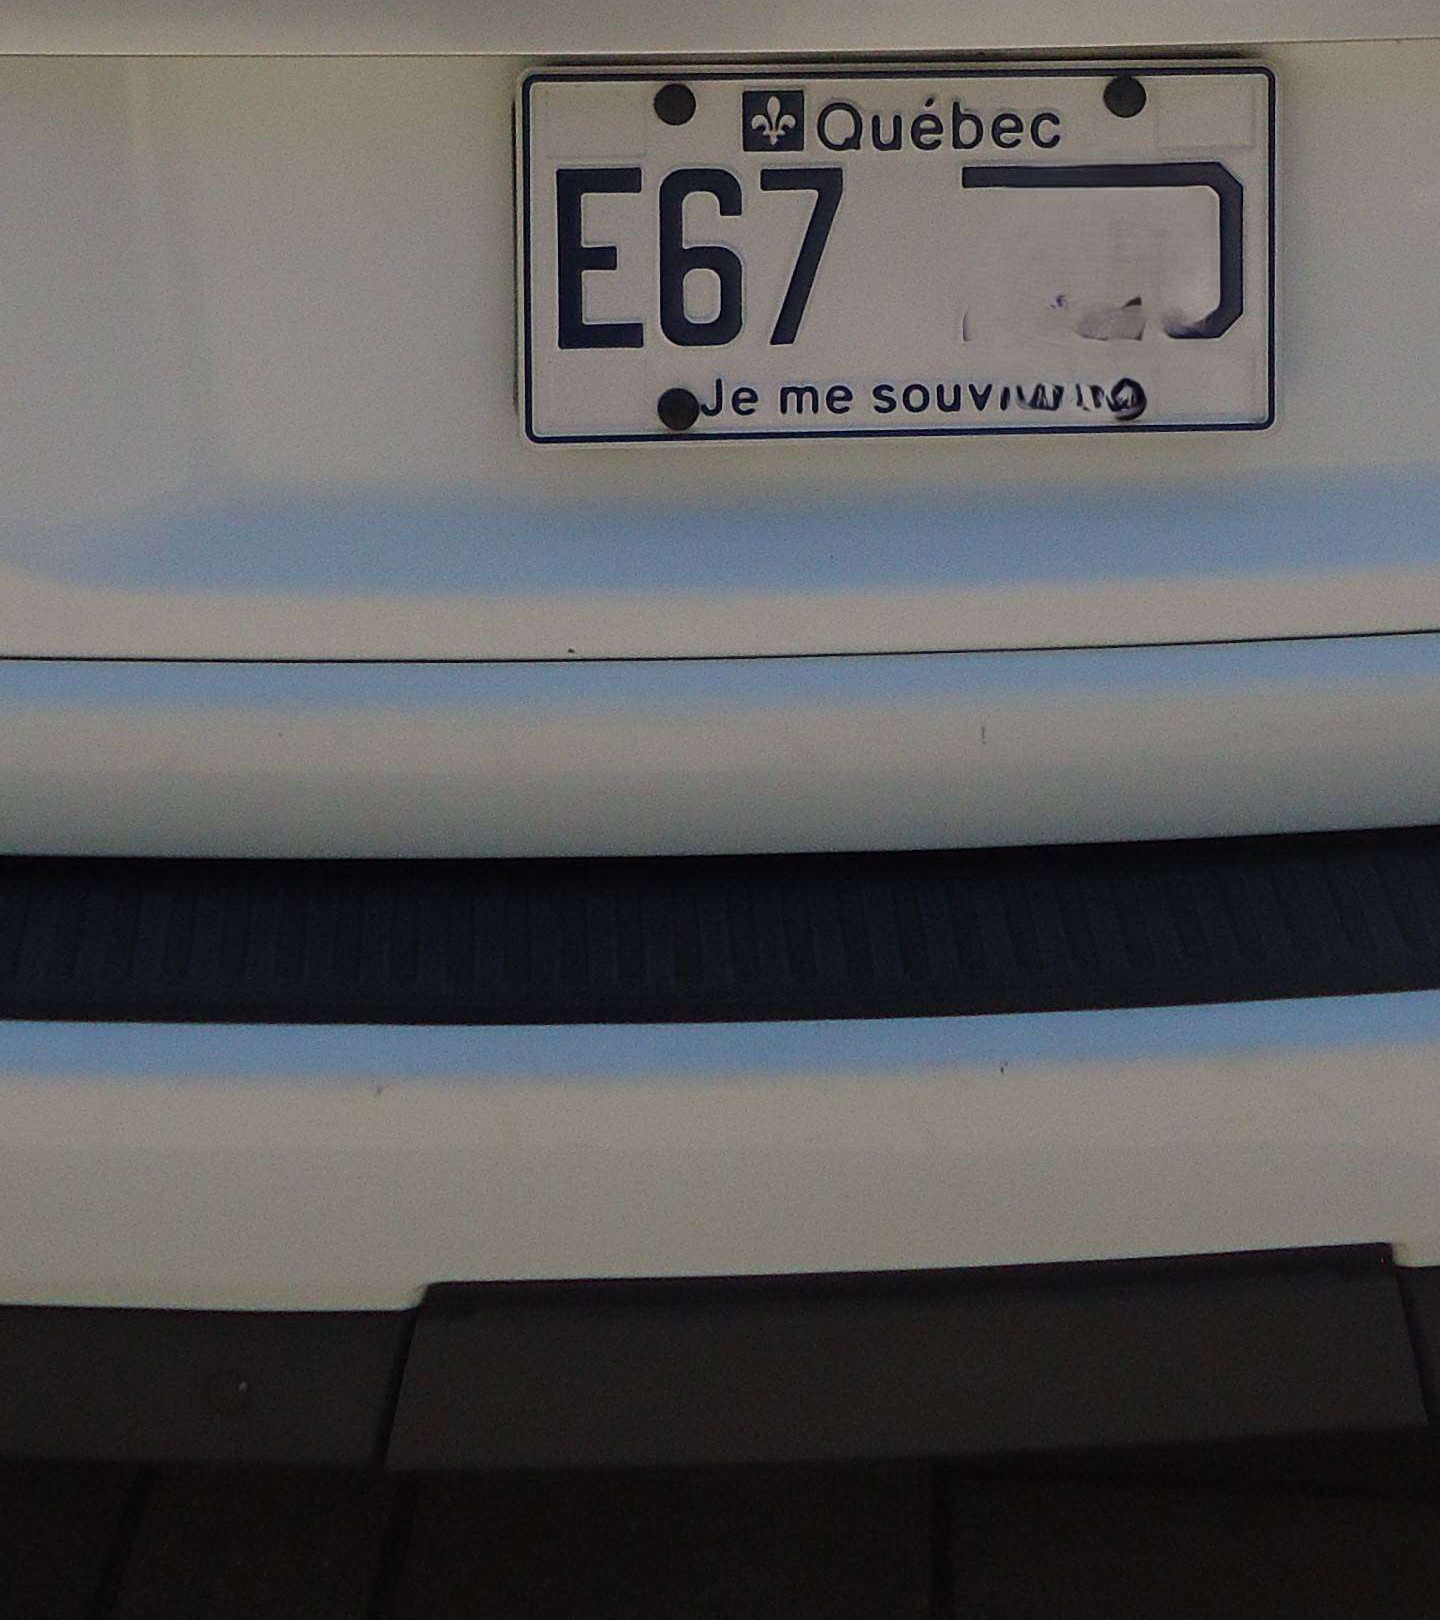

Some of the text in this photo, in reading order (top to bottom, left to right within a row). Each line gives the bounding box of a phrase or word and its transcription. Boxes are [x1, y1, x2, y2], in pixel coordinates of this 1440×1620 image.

[817, 98, 1061, 151] Québec
[700, 378, 759, 417] Je
[779, 383, 853, 415] me
